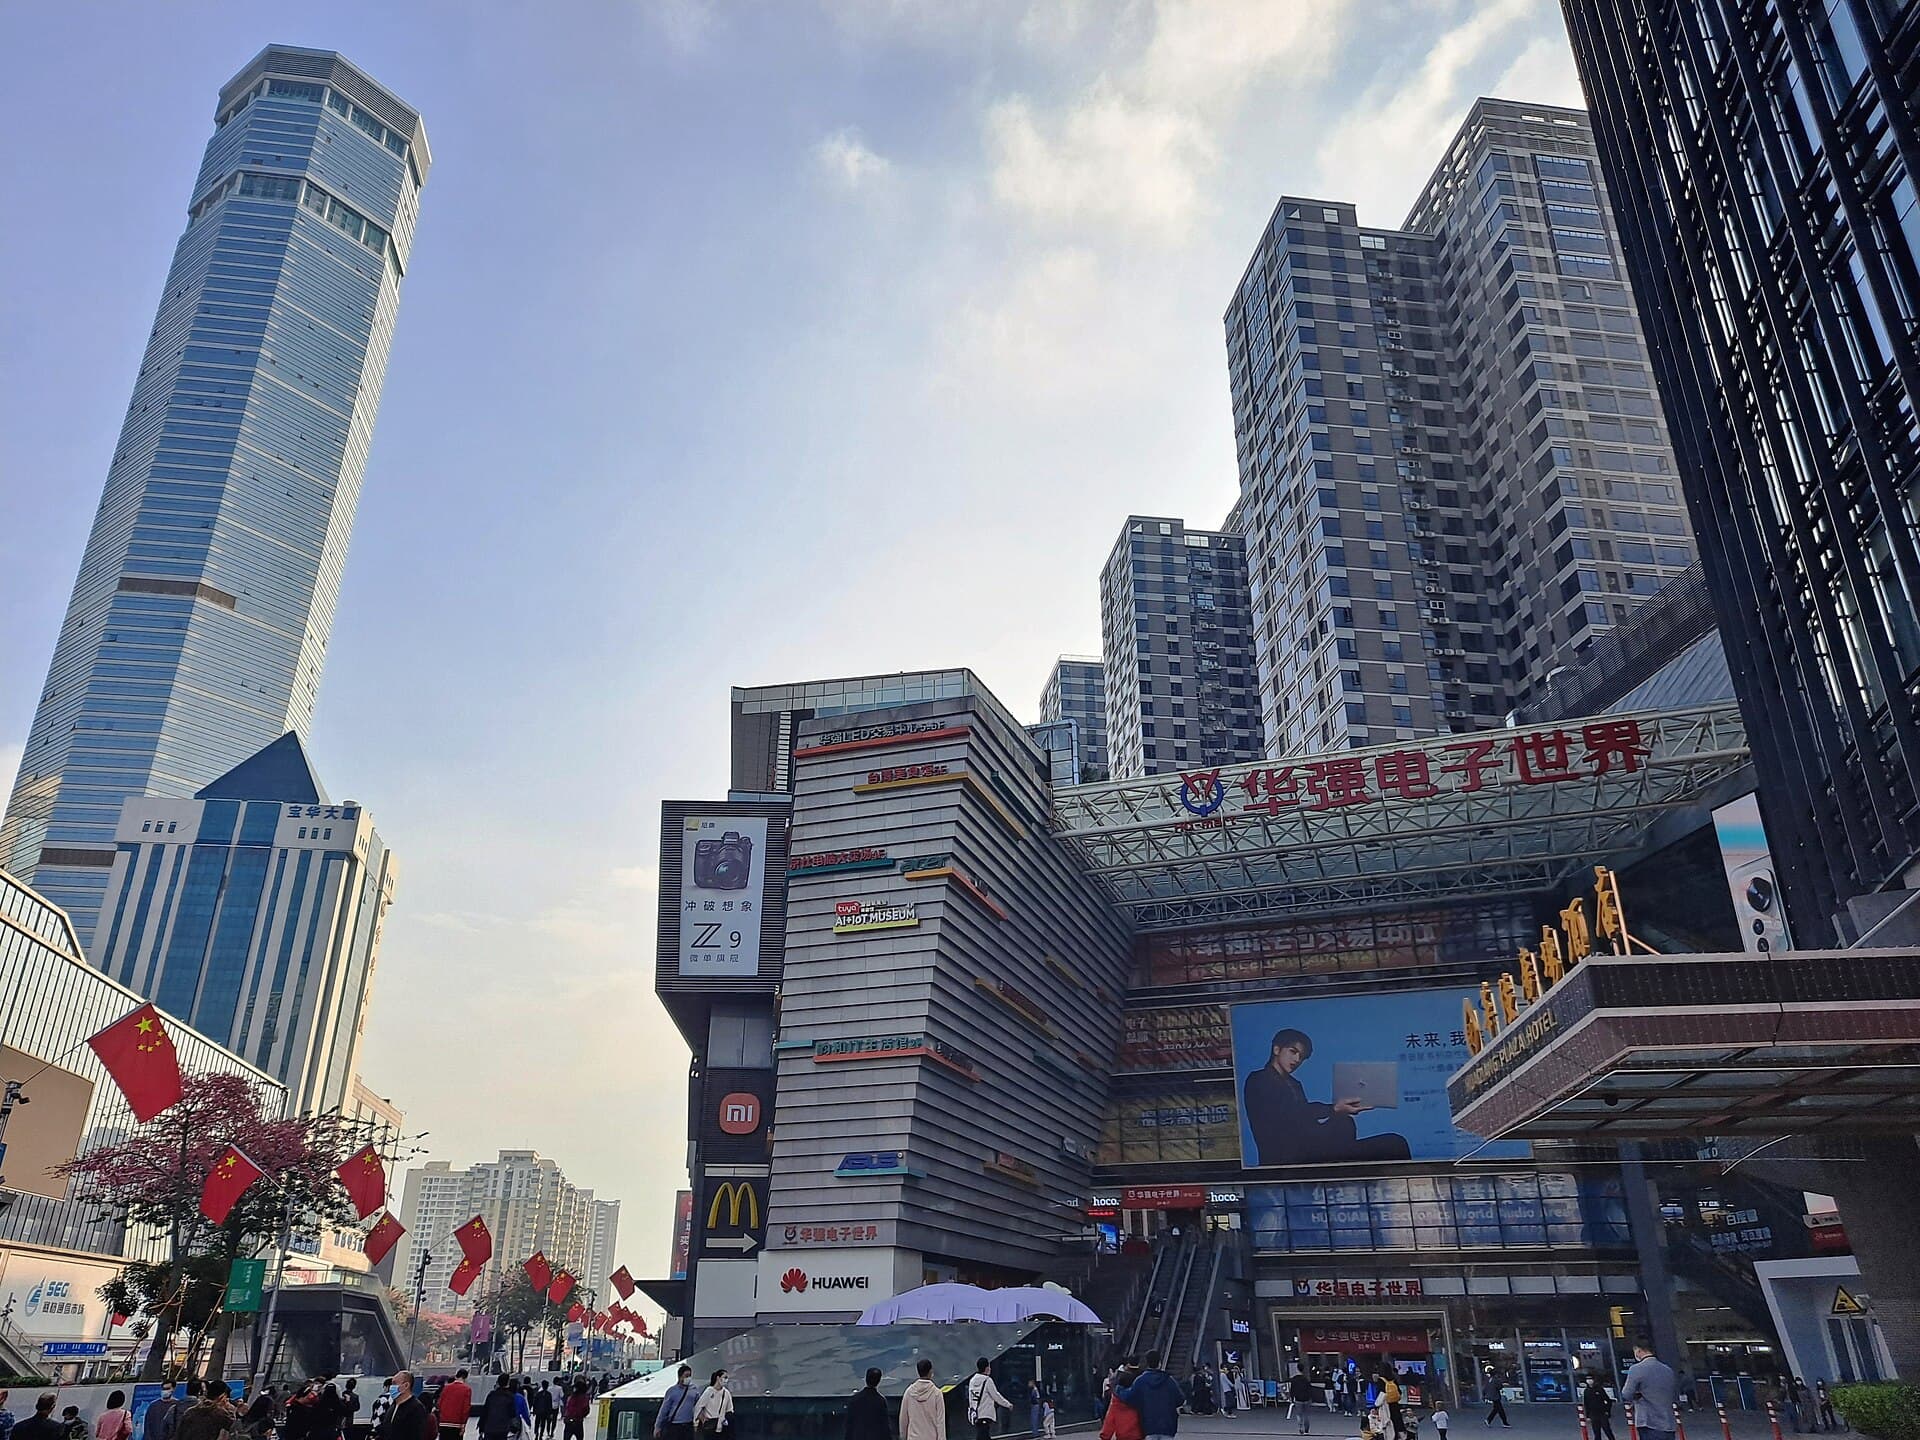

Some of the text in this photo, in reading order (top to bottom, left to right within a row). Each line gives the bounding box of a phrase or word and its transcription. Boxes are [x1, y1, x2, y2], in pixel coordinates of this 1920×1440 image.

[1241, 719, 1652, 817] 华强电子世界
[287, 805, 357, 821] 宝华大厦
[684, 900, 752, 912] 冲破想象
[838, 904, 857, 913] tuya
[870, 908, 915, 923] MUSEUM
[729, 931, 742, 948] 9
[1526, 1007, 1558, 1043] HOTEL
[837, 1152, 898, 1170] ASUS
[1092, 1196, 1120, 1206] hoco.
[1210, 1192, 1239, 1202] hoco.
[799, 1225, 878, 1243] 华强电子世界
[46, 1281, 70, 1297] SEG
[811, 1276, 869, 1289] HUAWEI
[1316, 1280, 1421, 1298] 华强电子世界
